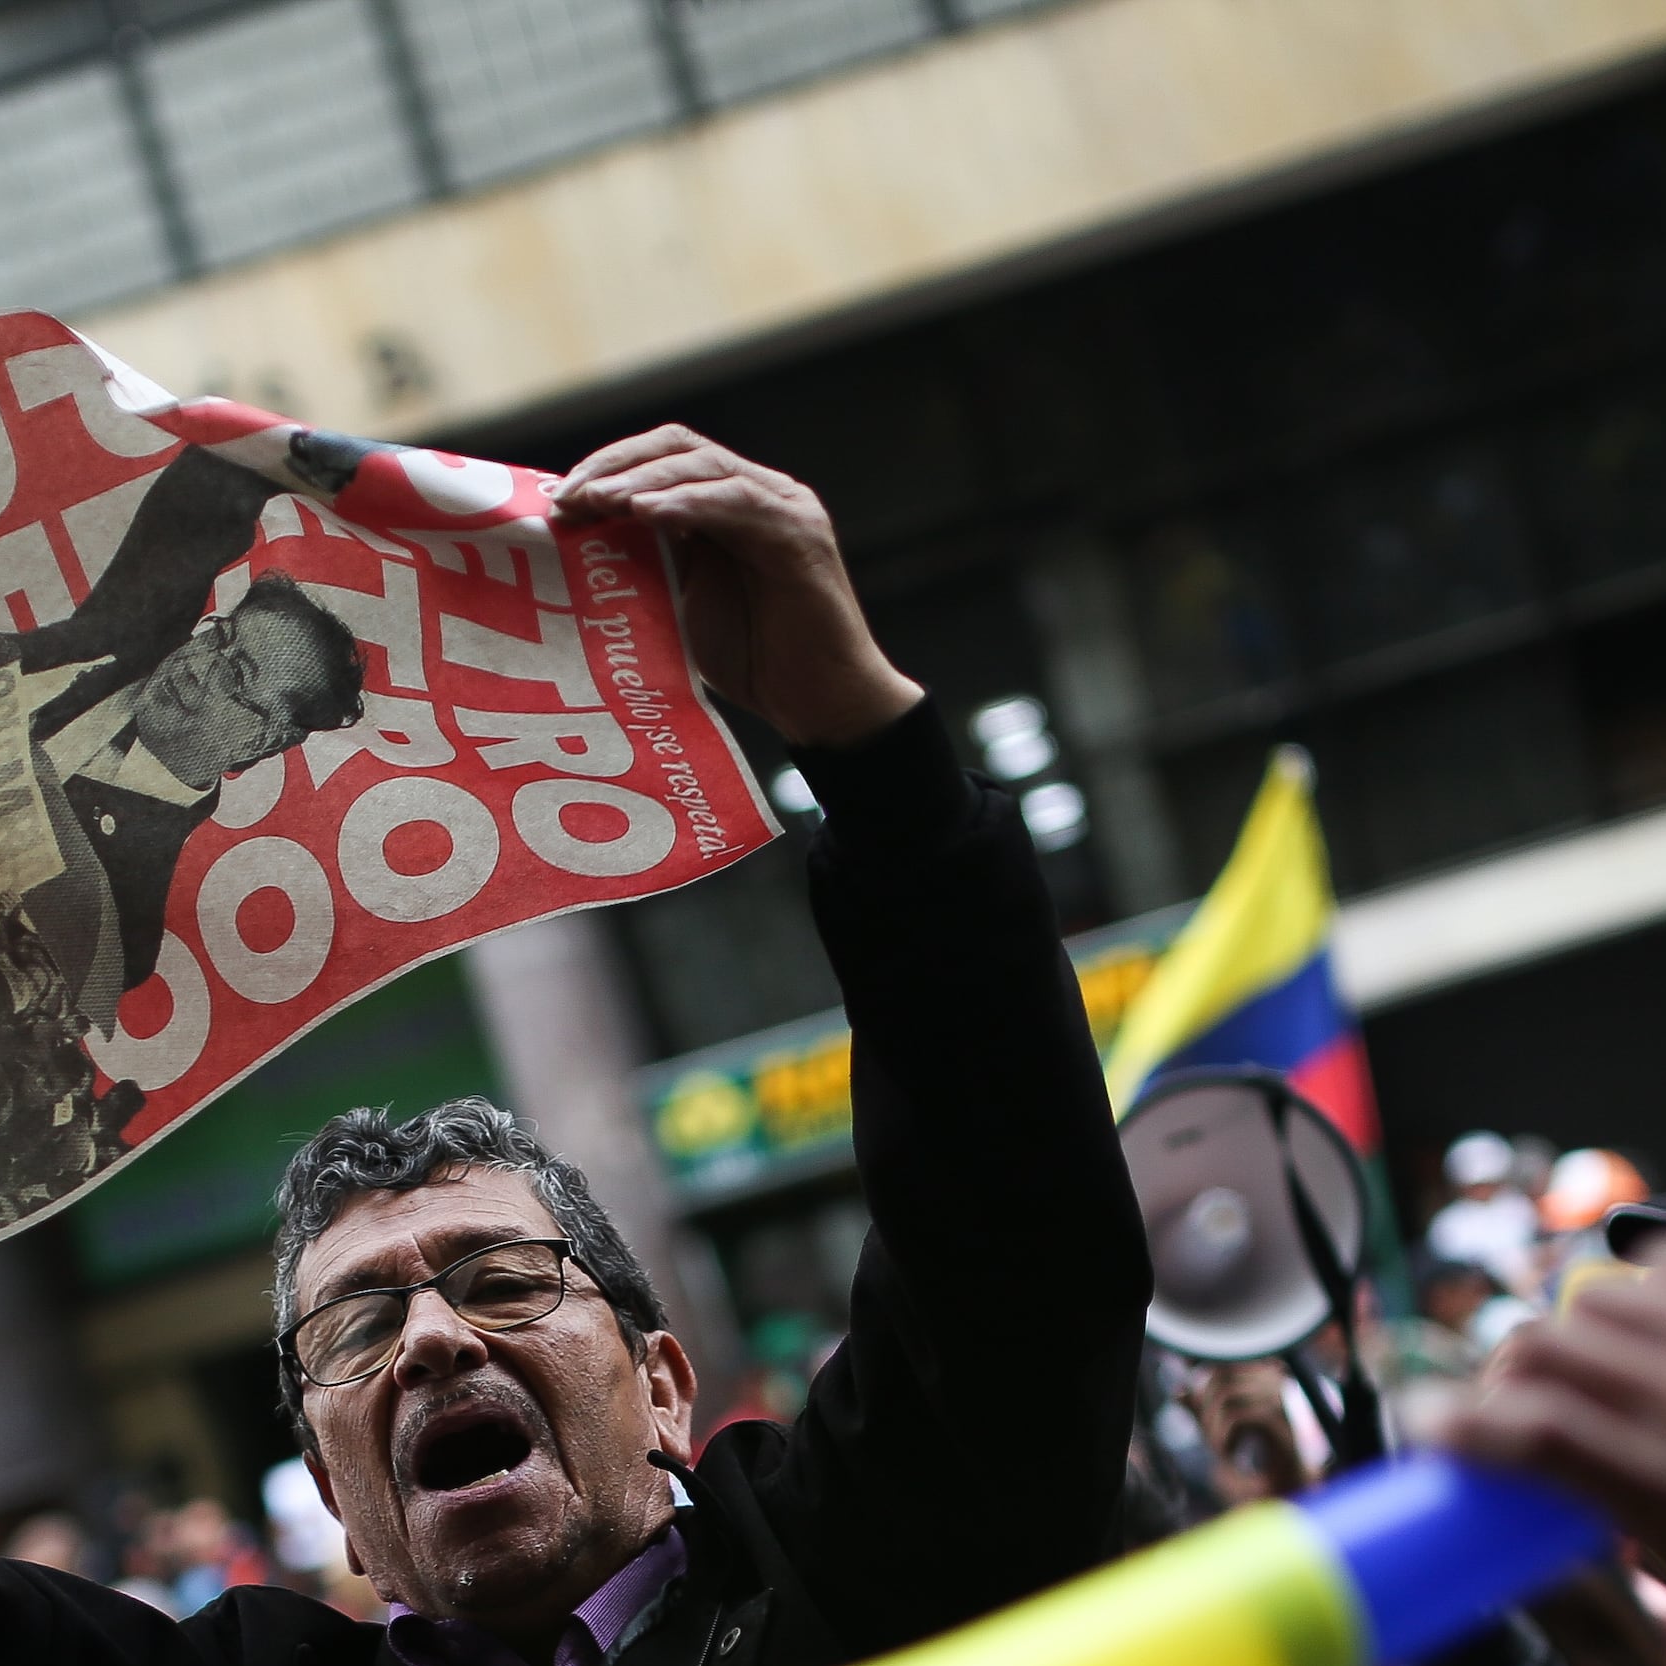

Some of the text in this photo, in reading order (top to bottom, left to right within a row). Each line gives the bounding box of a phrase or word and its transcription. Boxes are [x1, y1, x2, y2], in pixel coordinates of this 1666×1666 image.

[578, 537, 639, 605] del
[258, 492, 501, 923] ETRO
[583, 611, 673, 721] pueblo
[660, 759, 745, 861] respeta!
